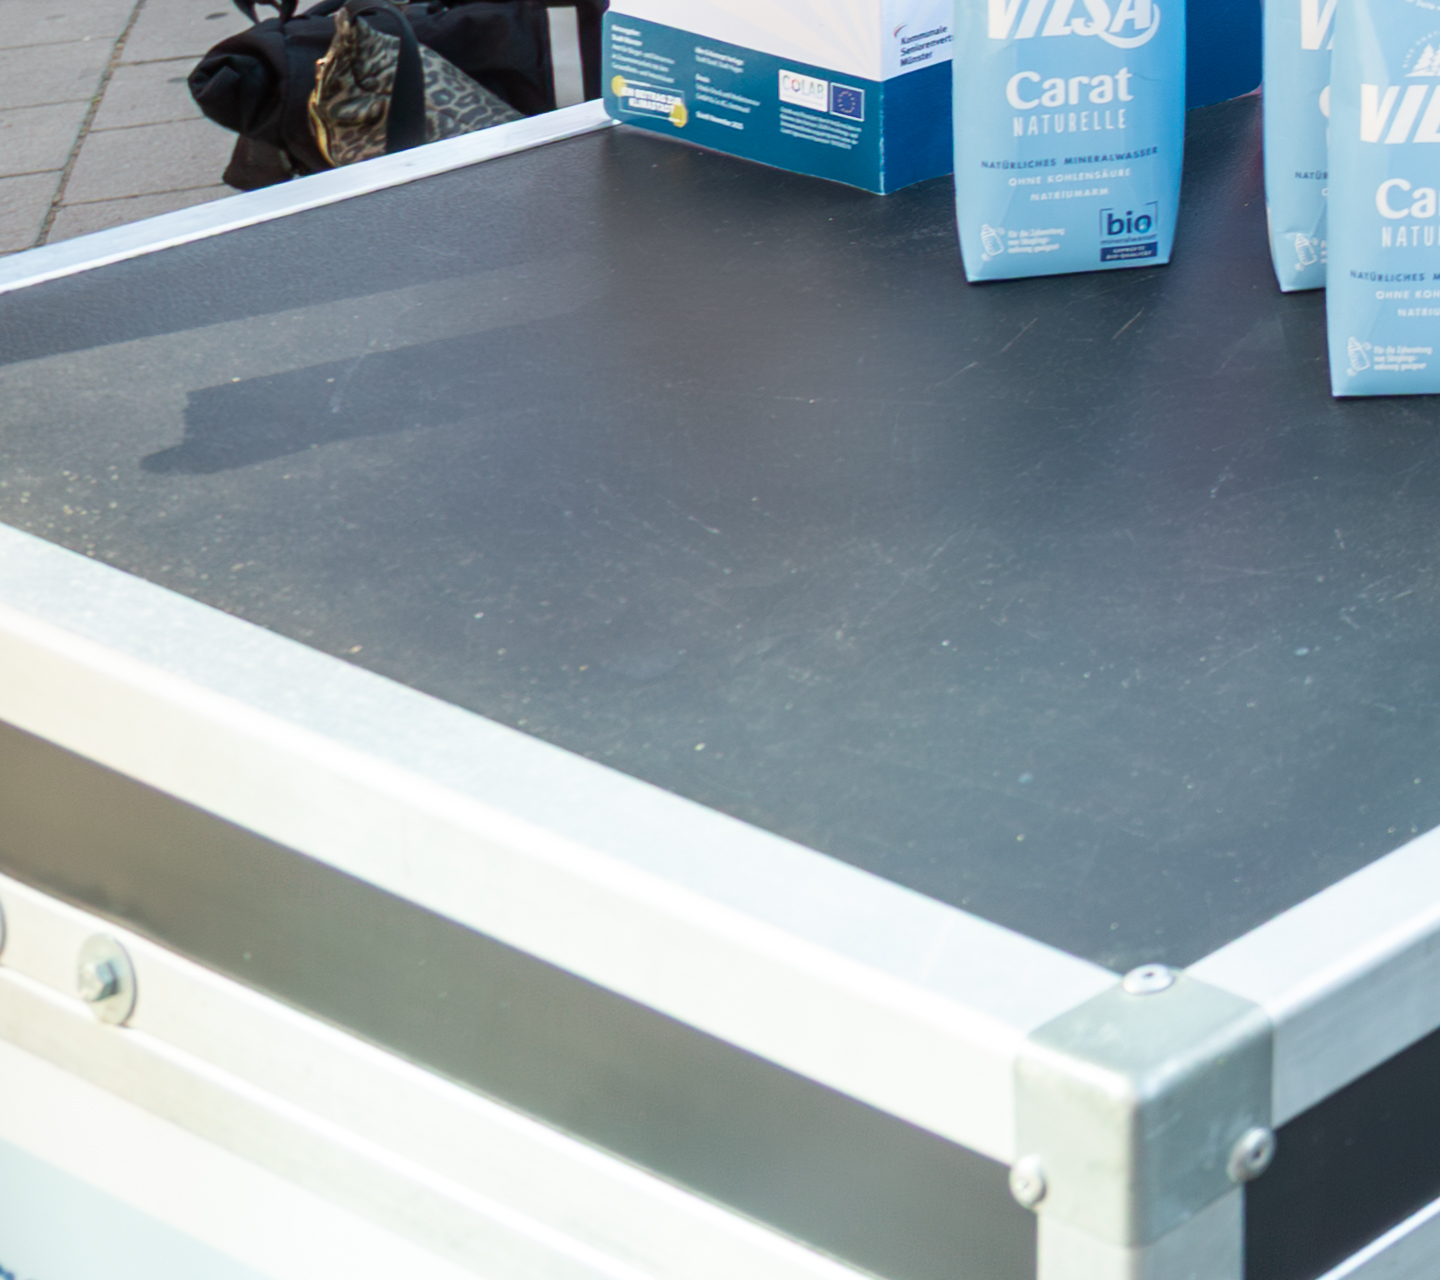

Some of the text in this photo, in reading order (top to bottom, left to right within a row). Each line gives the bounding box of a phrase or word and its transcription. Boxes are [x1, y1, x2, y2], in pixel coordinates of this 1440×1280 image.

[901, 24, 948, 45] Kommunale
[900, 50, 933, 67] Münster
[1006, 67, 1134, 109] Carat
[1013, 109, 1127, 137] NATURELLE
[981, 146, 1158, 170] NATÜRLICHES MINERALWASSER
[1008, 168, 1131, 187] OHNE KOHLENSÄURE
[1107, 210, 1152, 236] bio
[1350, 270, 1425, 282] NATÜRLICHES
[1375, 290, 1410, 300] OHNE
